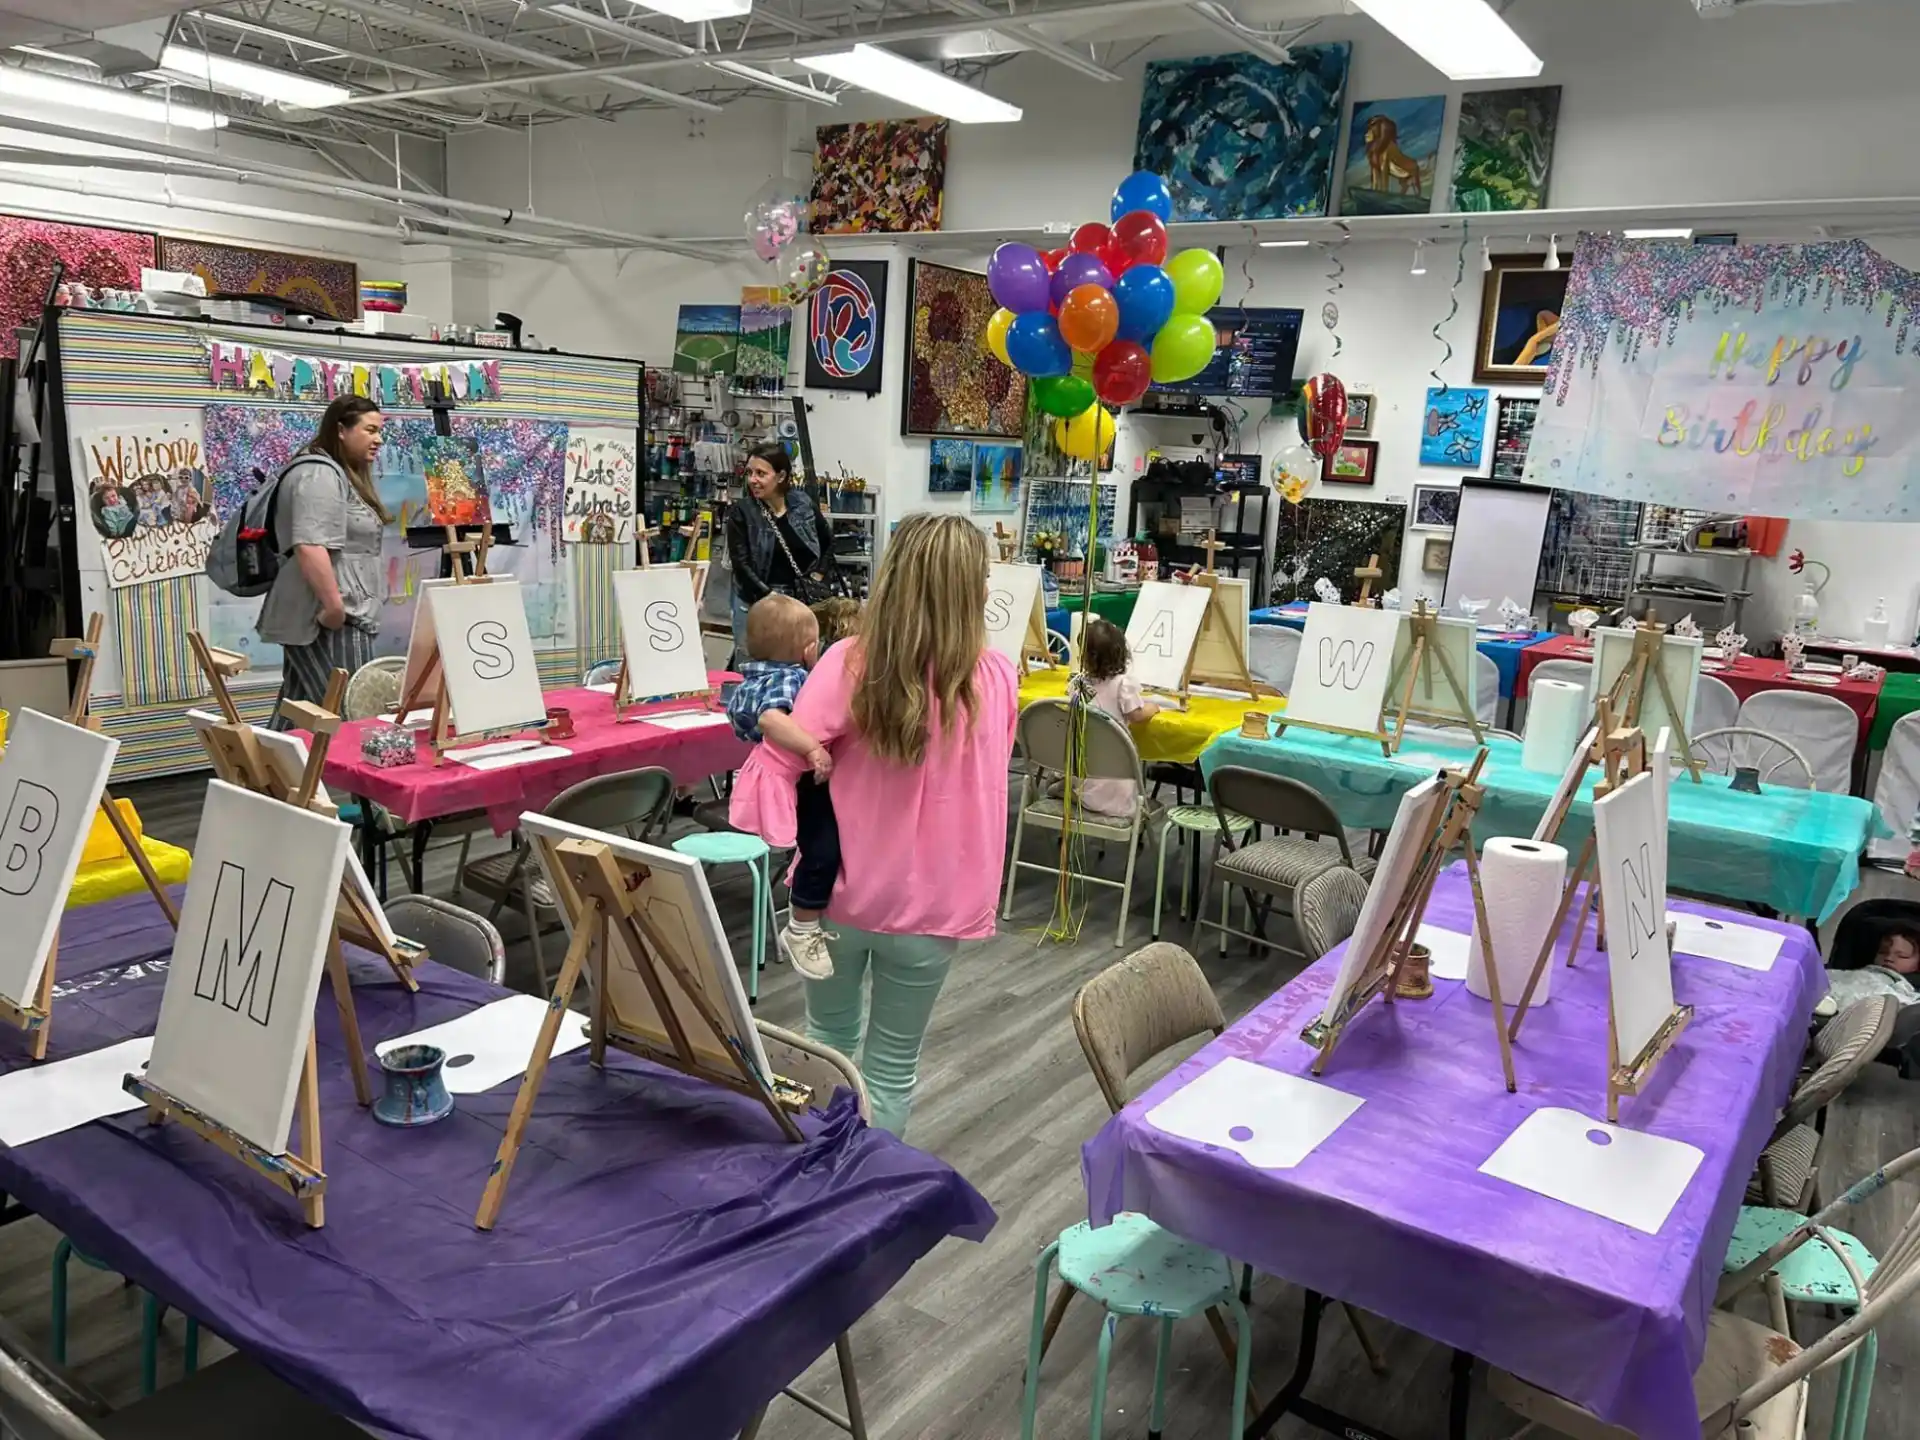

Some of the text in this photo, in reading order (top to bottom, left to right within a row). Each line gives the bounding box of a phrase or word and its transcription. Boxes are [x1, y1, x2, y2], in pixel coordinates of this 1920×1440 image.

[212, 342, 341, 400] HAPPY
[1708, 332, 1866, 391] Happy
[91, 436, 201, 487] Welcome
[1657, 400, 1879, 476] Birthday
[564, 490, 632, 518] Celebrate
[644, 600, 684, 652] S
[985, 589, 1014, 631] S
[1133, 609, 1174, 657] A
[466, 620, 514, 679] S
[1319, 636, 1375, 691] W
[0, 778, 60, 896] B
[1621, 842, 1656, 960] N
[195, 860, 295, 1027] M
